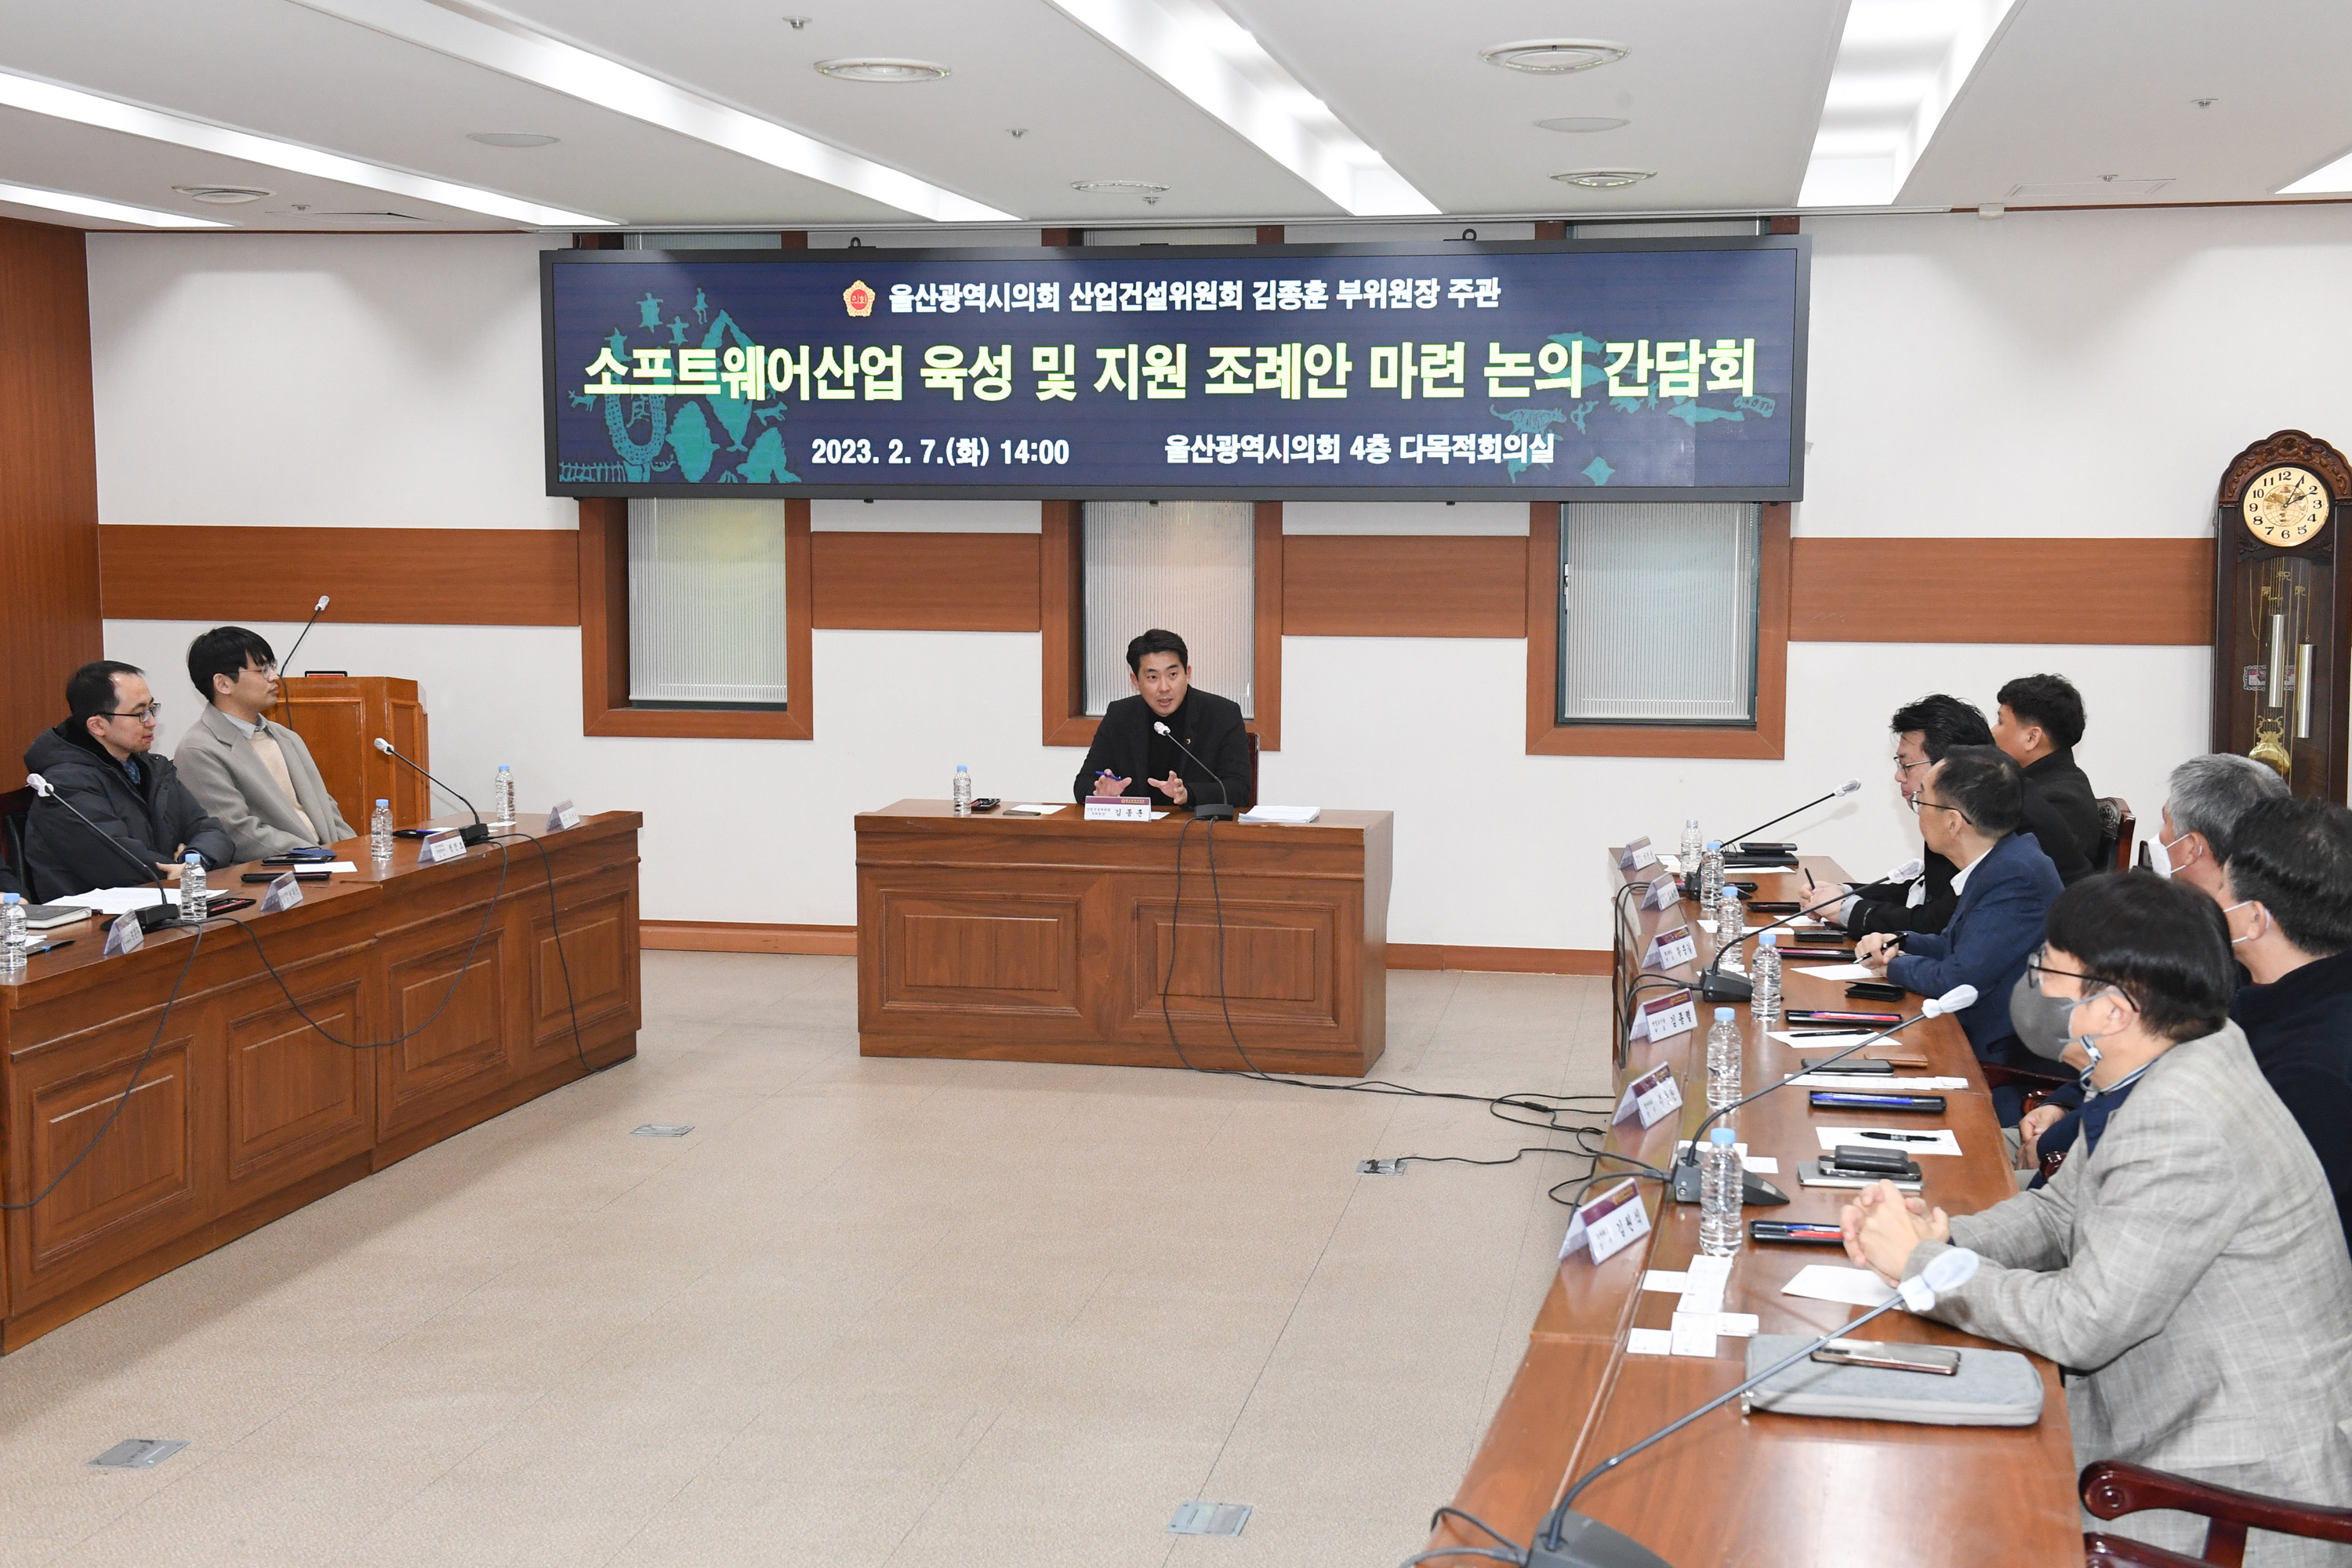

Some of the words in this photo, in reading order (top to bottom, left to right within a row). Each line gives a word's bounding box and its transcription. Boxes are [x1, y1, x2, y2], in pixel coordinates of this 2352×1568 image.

[890, 281, 1060, 312] 울산광역시의회
[1069, 280, 1243, 312] 산업건설위원회
[1253, 279, 1329, 310] 김종훈
[1337, 278, 1441, 310] 부위원장
[1448, 277, 1501, 308] 주관
[584, 345, 902, 401] 소프트웨어산업
[920, 344, 1012, 401] 육성
[1033, 344, 1077, 401] 및
[1093, 343, 1187, 401] 지원
[1205, 343, 1352, 400] 조례안
[1370, 341, 1465, 399] 마련
[1483, 340, 1583, 398] 논의
[1603, 339, 1755, 397] 간담회
[811, 438, 879, 464] 2023.
[888, 438, 911, 464] 2.
[920, 437, 989, 467] 7.(화)
[1000, 439, 1069, 465] 14:00
[1165, 434, 1340, 464] 울산광역시의회
[1349, 434, 1392, 464] 4층
[1400, 433, 1555, 464] 다목적회의실
[2278, 470, 2292, 481] 12
[2263, 477, 2274, 486] 11
[2252, 488, 2264, 499] 10
[2309, 485, 2318, 495] 2
[2249, 503, 2258, 512] 9
[2313, 499, 2322, 509] 3
[2252, 516, 2263, 525] 8
[2307, 514, 2317, 522] 4
[2264, 526, 2274, 535] 7
[2281, 529, 2290, 539] 6
[2297, 524, 2307, 535] 5
